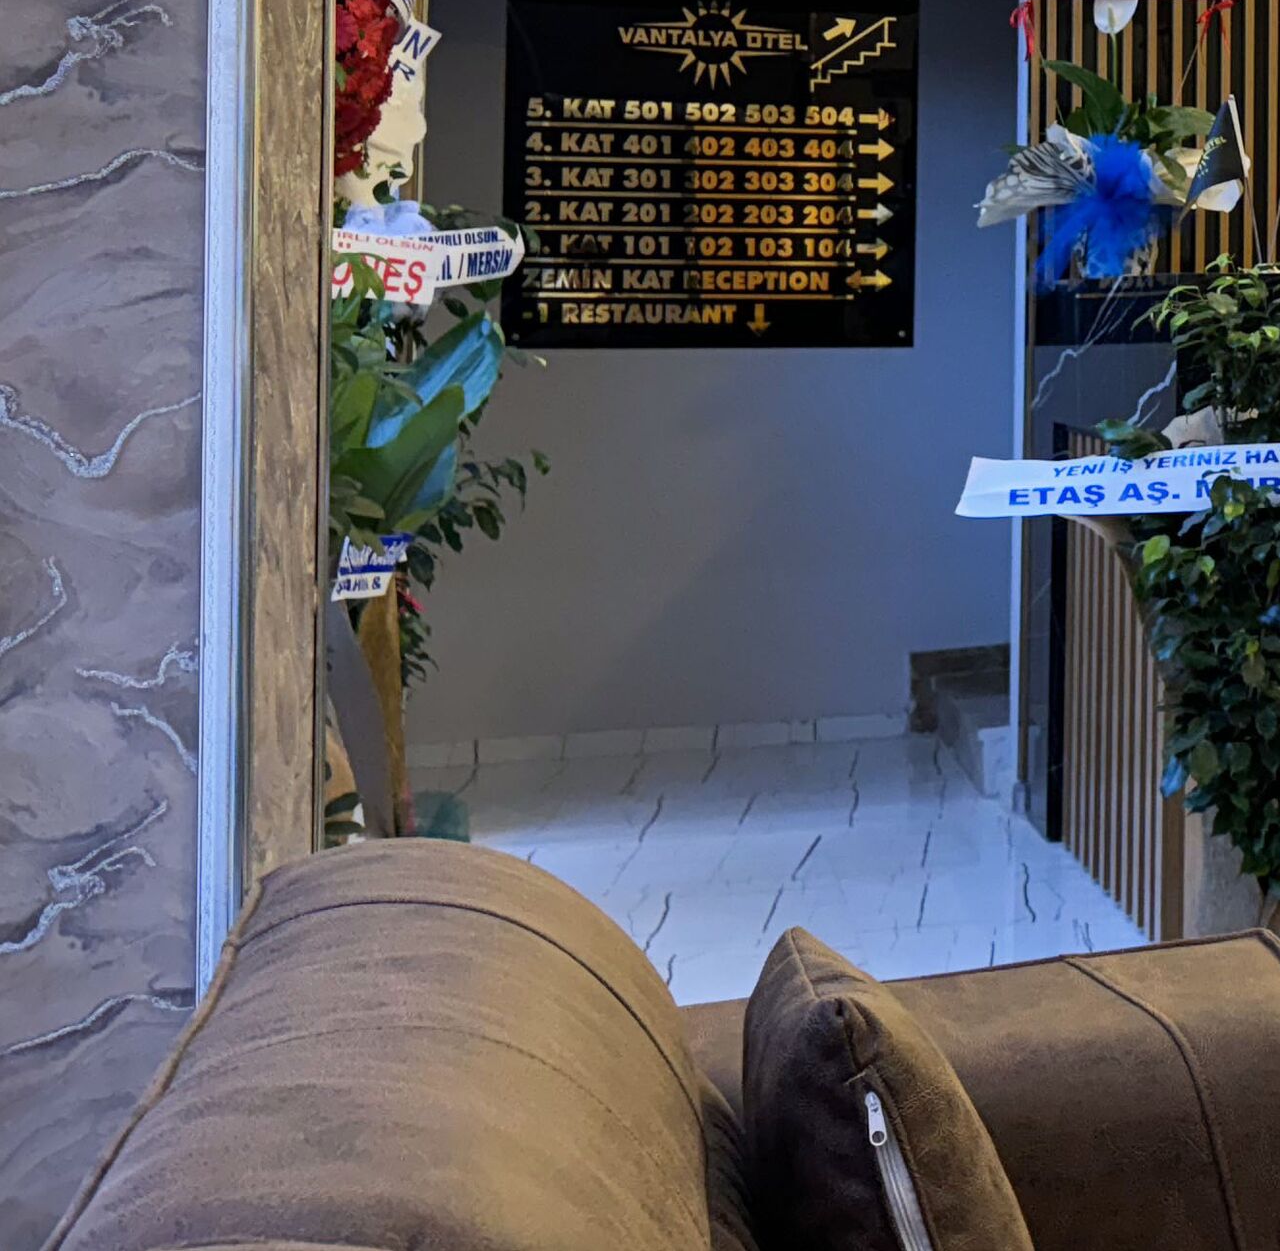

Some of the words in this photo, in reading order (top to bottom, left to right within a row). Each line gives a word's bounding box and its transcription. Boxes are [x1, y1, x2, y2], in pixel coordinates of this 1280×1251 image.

[618, 27, 738, 48] VANTALYA
[747, 32, 808, 50] OTEL
[527, 98, 552, 119] 5.
[563, 98, 615, 119] KAT
[623, 101, 672, 121] 501
[685, 103, 736, 122] 502
[745, 104, 795, 124] 503
[805, 106, 854, 126] 504
[526, 131, 552, 152] 4.
[561, 133, 614, 153] KAT
[623, 134, 671, 154] 401
[685, 136, 734, 156] 402
[745, 137, 794, 158] 403
[804, 139, 853, 159] 404
[526, 166, 552, 187] 3.
[561, 167, 614, 188] KAT
[623, 168, 671, 188] 301
[684, 170, 734, 190] 302
[745, 171, 794, 191] 303
[804, 173, 853, 192] 304
[525, 201, 551, 221] 2.
[559, 201, 613, 222] KAT
[622, 203, 670, 223] 201
[684, 204, 734, 224] 202
[743, 205, 794, 225] 203
[803, 206, 853, 226] 204
[560, 234, 612, 255] KAT
[623, 235, 670, 255] 101
[685, 237, 733, 256] 102
[745, 237, 793, 257] 103
[805, 238, 852, 258] 104
[466, 244, 513, 278] MERSİN
[622, 269, 675, 290] KAT
[683, 270, 829, 291] RECEPTION
[561, 303, 737, 324] RESTAURANT
[1054, 461, 1105, 478] YENİ
[1144, 449, 1237, 469] YERİNİZ
[1008, 484, 1105, 509] ETAŞ
[1118, 481, 1180, 505] AŞ.
